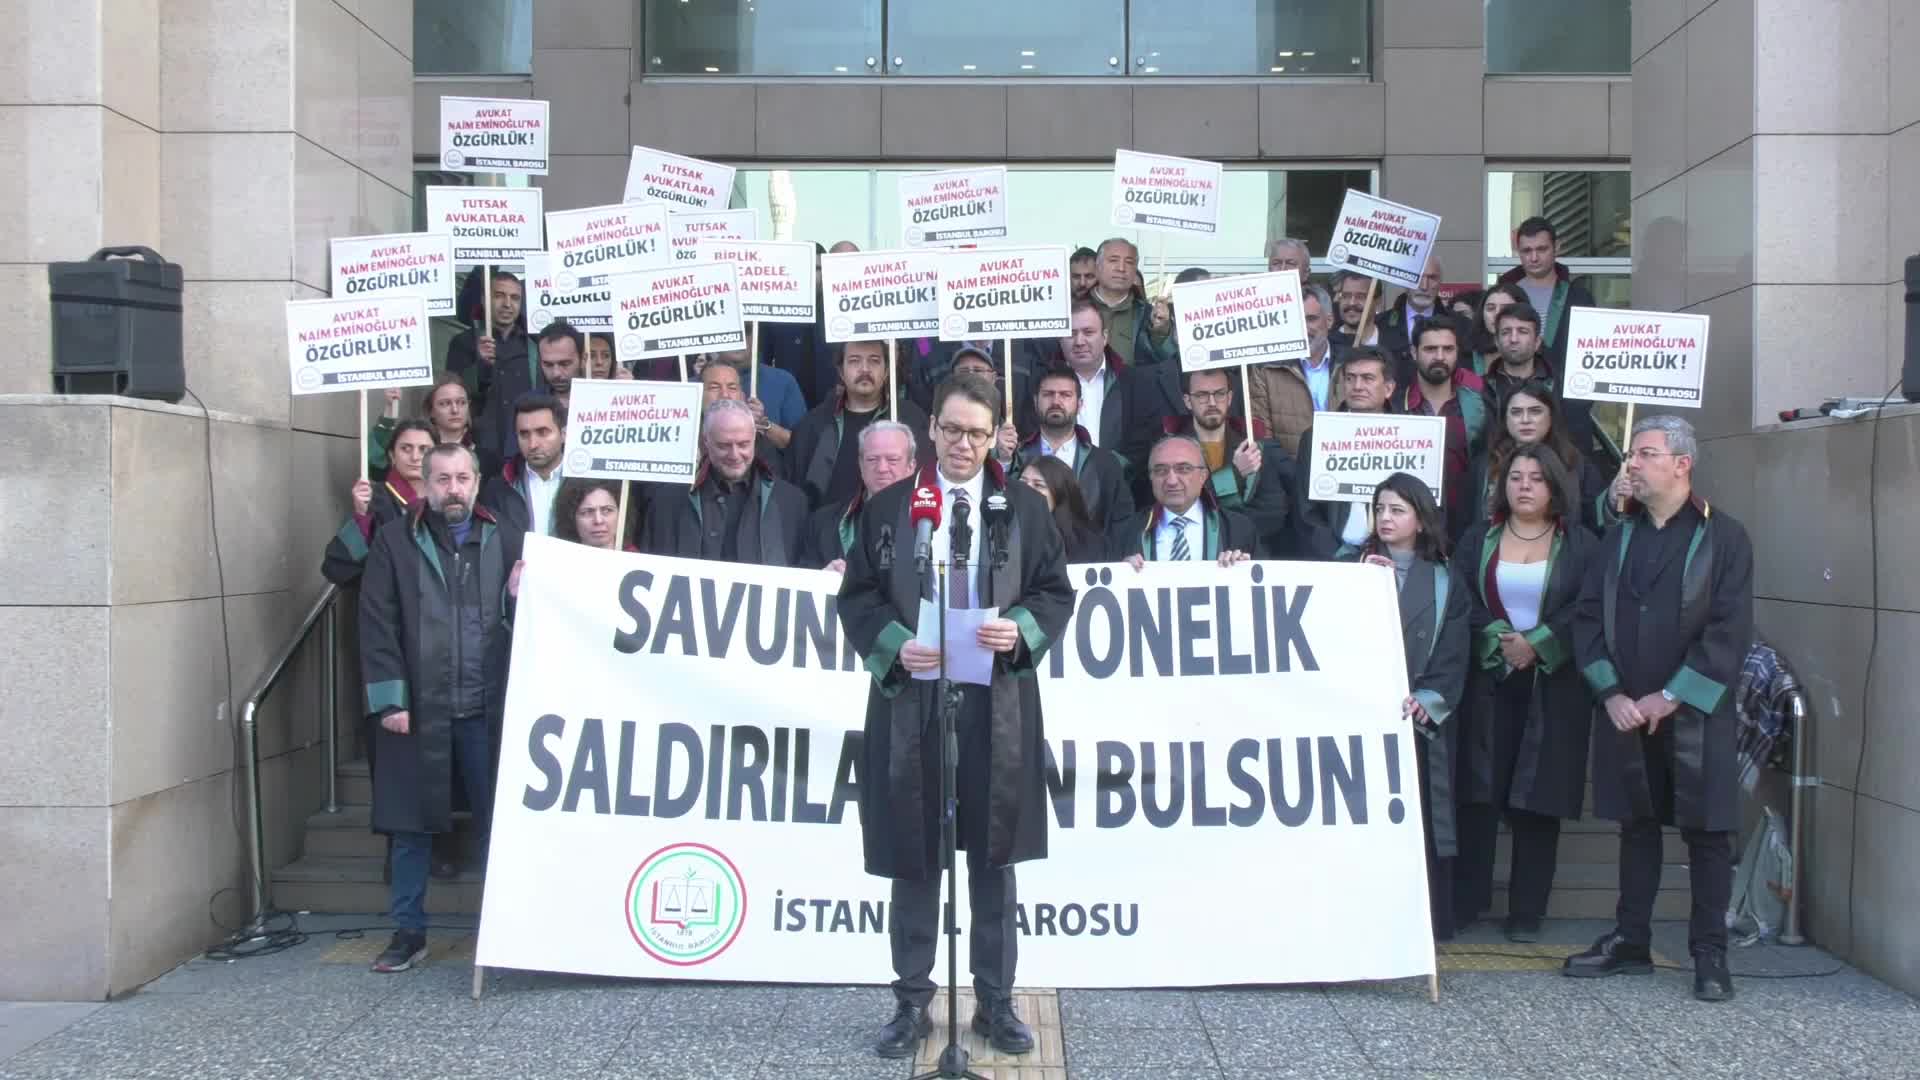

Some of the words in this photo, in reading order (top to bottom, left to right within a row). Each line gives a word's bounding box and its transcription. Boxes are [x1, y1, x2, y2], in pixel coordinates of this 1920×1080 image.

[476, 108, 512, 118] AVUKAT
[448, 120, 474, 130] NAİM
[453, 131, 527, 146] ÖZGÜRLÜK
[476, 157, 512, 168] İSTANBUL
[662, 164, 703, 180] TUTSAK
[1150, 167, 1185, 177] AVUKAT
[644, 174, 715, 196] AVUKATLARA
[933, 178, 969, 192] AVUKAT
[1121, 176, 1147, 186] NAİM
[647, 186, 707, 207] ÖZGÜRLÜK!
[908, 196, 932, 208] NAİM
[1125, 188, 1198, 206] ÖZGÜRLÜK
[462, 200, 508, 208] TUTSAK
[446, 213, 525, 223] AVUKATLARA
[913, 200, 986, 224] ÖZGÜRLÜK
[1371, 210, 1407, 224] AVUKAT
[586, 216, 627, 231] AVUKAT
[686, 222, 727, 232] TUTSAK
[1146, 214, 1180, 227] İSTANBUL
[1344, 216, 1368, 230] NAİM
[453, 225, 518, 237] ÖZGÜRLÜK!
[936, 230, 972, 240] İSTANBUL
[557, 236, 585, 249] NAİM
[1344, 228, 1412, 256] ÖZGÜRLÜK
[370, 244, 411, 258] AVUKAT
[563, 240, 648, 268] ÖZGÜRLÜK
[341, 262, 369, 276] NAİM
[864, 260, 908, 275] AVUKAT
[980, 258, 1024, 272] AVUKAT
[1356, 257, 1389, 275] İSTANBUL
[347, 270, 430, 294] ÖZGÜRLÜK
[652, 275, 694, 291] AVUKAT
[740, 280, 798, 293] ANIŞMA!
[832, 278, 862, 293] NAİM
[947, 278, 977, 291] NAİM
[839, 288, 929, 312] ÖZGÜRLÜK
[954, 286, 1044, 311] ÖZGÜRLÜK
[1215, 286, 1257, 303] AVUKAT
[620, 296, 650, 311] NAİM
[333, 307, 379, 323] AVUKAT
[628, 300, 717, 330] ÖZGÜRLÜK
[1184, 307, 1214, 323] NAİM
[868, 321, 913, 331] İSTANBUL
[914, 319, 939, 329] BARO
[983, 321, 1027, 331] İSTANBUL
[1192, 310, 1280, 341] ÖZGÜRLÜK
[1613, 324, 1661, 335] AVUKAT
[298, 327, 331, 342] NAİM
[306, 336, 401, 362] ÖZGÜRLÜK
[658, 336, 702, 349] İSTANBUL
[1577, 336, 1610, 349] NAİM
[1223, 346, 1265, 360] İSTANBUL
[1582, 350, 1677, 370] ÖZGÜRLÜK
[337, 370, 385, 383] İSTANBUL
[1608, 383, 1656, 396] İSTANBUL
[612, 394, 656, 406] AVUKAT
[577, 411, 607, 423] NAİM
[581, 424, 672, 445] ÖZGÜRLÜK
[1355, 426, 1400, 437] AVUKAT
[1320, 441, 1351, 451] NAİM
[606, 460, 649, 472] İSTANBUL
[1326, 453, 1416, 471] ÖZGÜRLÜK
[614, 570, 864, 672] SAVUN
[522, 714, 864, 824] SALDIRILA
[1096, 737, 1368, 828] BULSUN
[1016, 903, 1138, 936] AROSU
